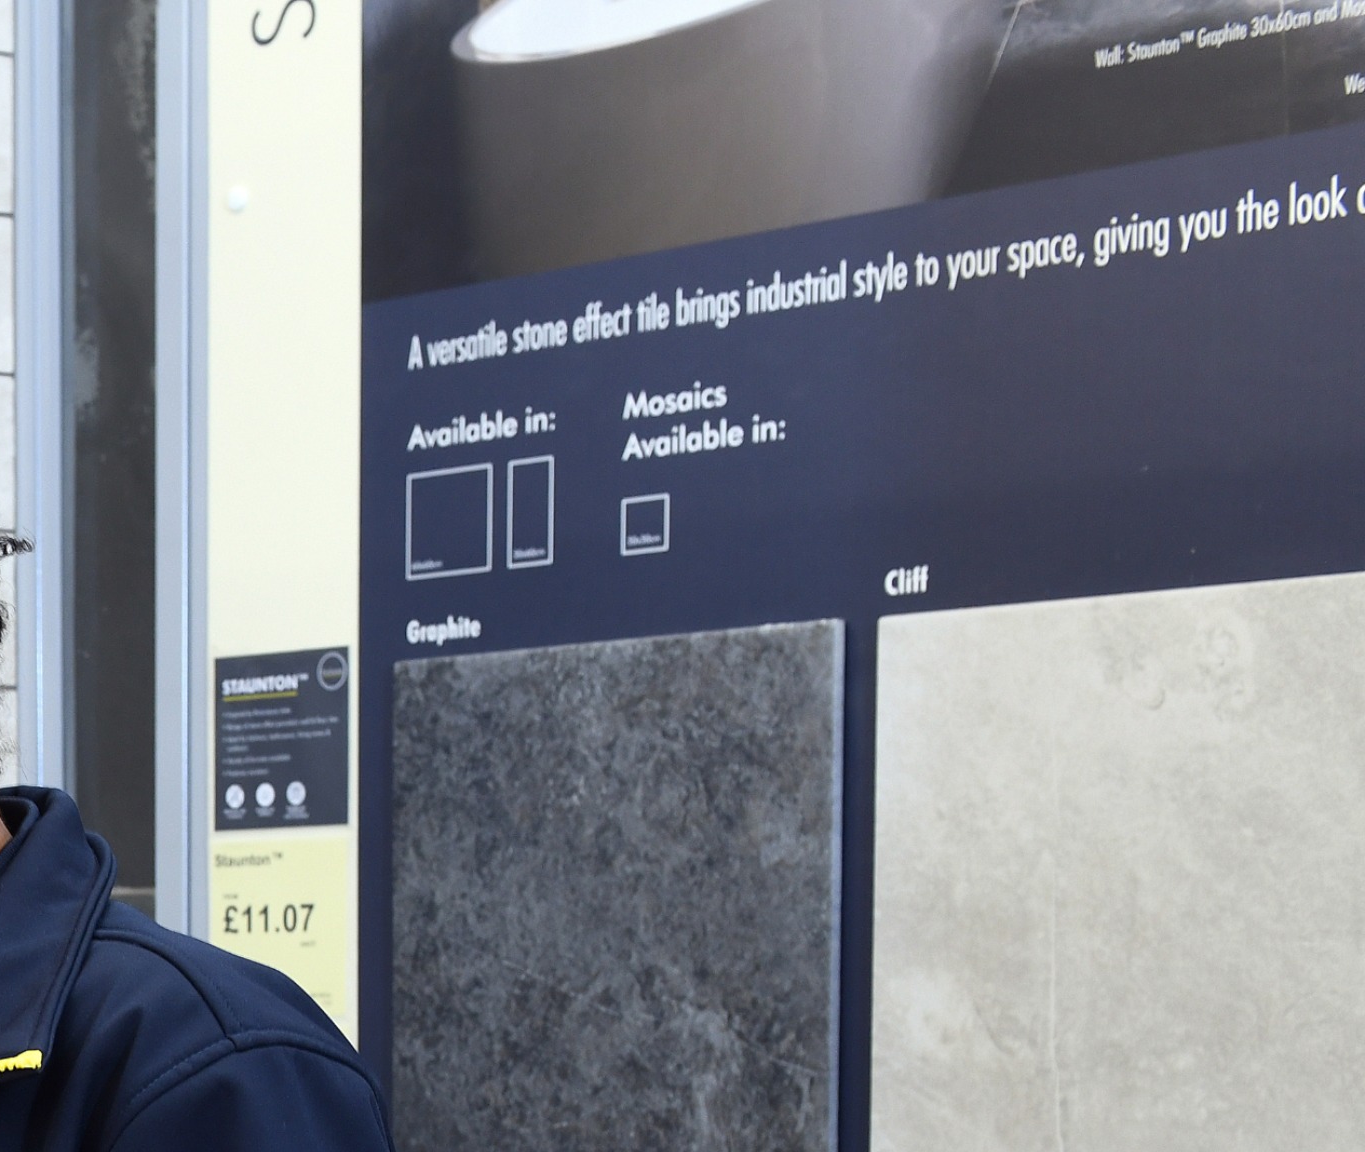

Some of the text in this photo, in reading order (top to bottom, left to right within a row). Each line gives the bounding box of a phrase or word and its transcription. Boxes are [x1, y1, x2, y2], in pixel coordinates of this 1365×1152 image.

[1094, 50, 1125, 69] Wall:
[1197, 22, 1248, 49] Graphite
[1250, 10, 1311, 38] 30x60cm
[1313, 0, 1338, 25] and
[407, 334, 424, 370] A
[426, 319, 508, 367] versatile
[512, 318, 568, 354] stone
[572, 300, 633, 343] effect
[636, 291, 670, 333] tile
[675, 286, 740, 329] brings
[746, 258, 847, 315] industrial
[853, 250, 908, 303] style
[914, 252, 940, 287] to
[946, 245, 1001, 291] your
[1007, 232, 1085, 279] space,
[1093, 213, 1170, 267] giving
[1178, 207, 1228, 253] you
[1235, 188, 1279, 234] the
[1288, 174, 1348, 226] look
[622, 380, 728, 421] Mosaics
[406, 405, 556, 452] Available in:
[621, 413, 786, 461] Available in:
[884, 563, 929, 596] Cliff
[406, 614, 482, 646] Graphite
[223, 902, 316, 935] £11.07
